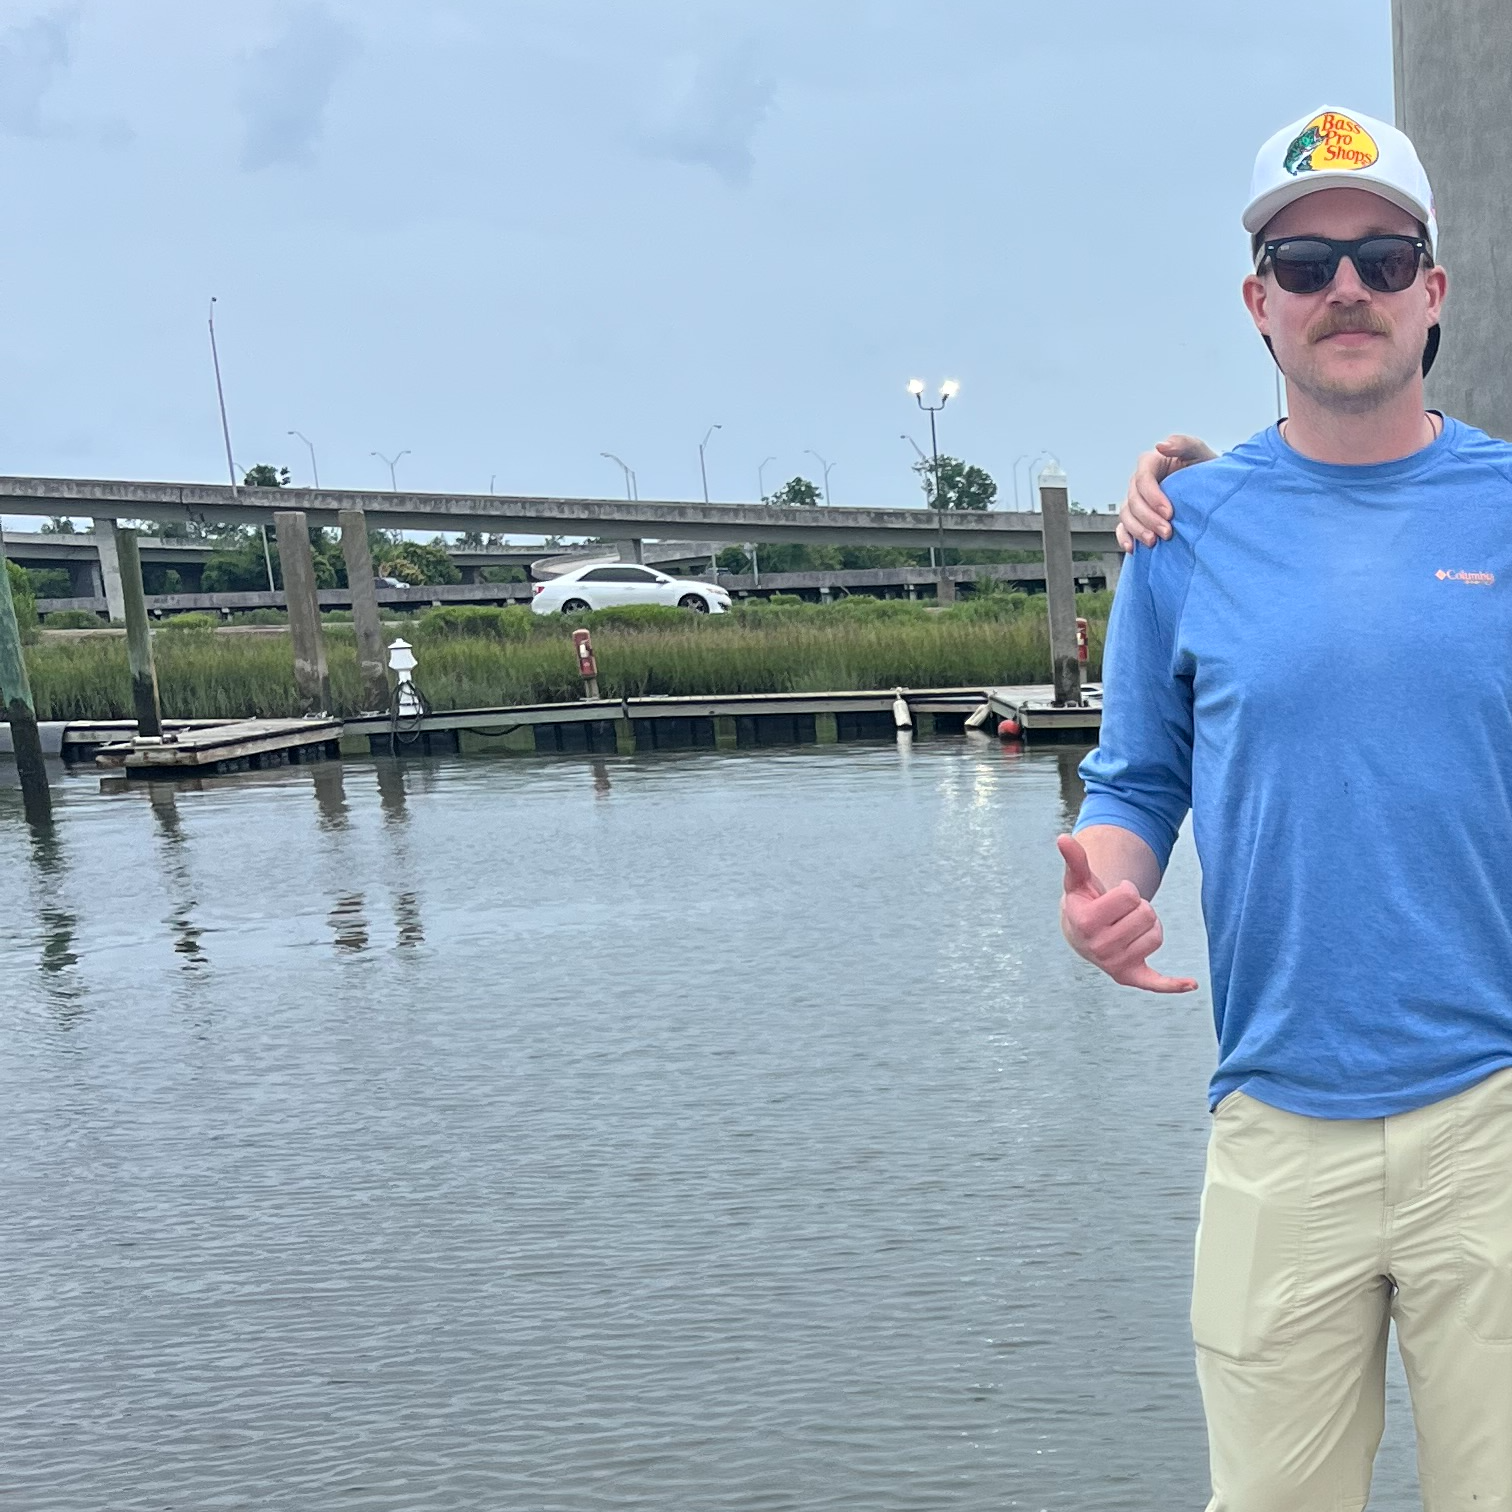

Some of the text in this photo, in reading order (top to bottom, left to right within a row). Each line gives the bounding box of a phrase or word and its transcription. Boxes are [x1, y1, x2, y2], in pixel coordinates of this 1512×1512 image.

[1321, 114, 1361, 134] Bass
[1324, 131, 1353, 146] Pro
[1323, 145, 1372, 165] Shops
